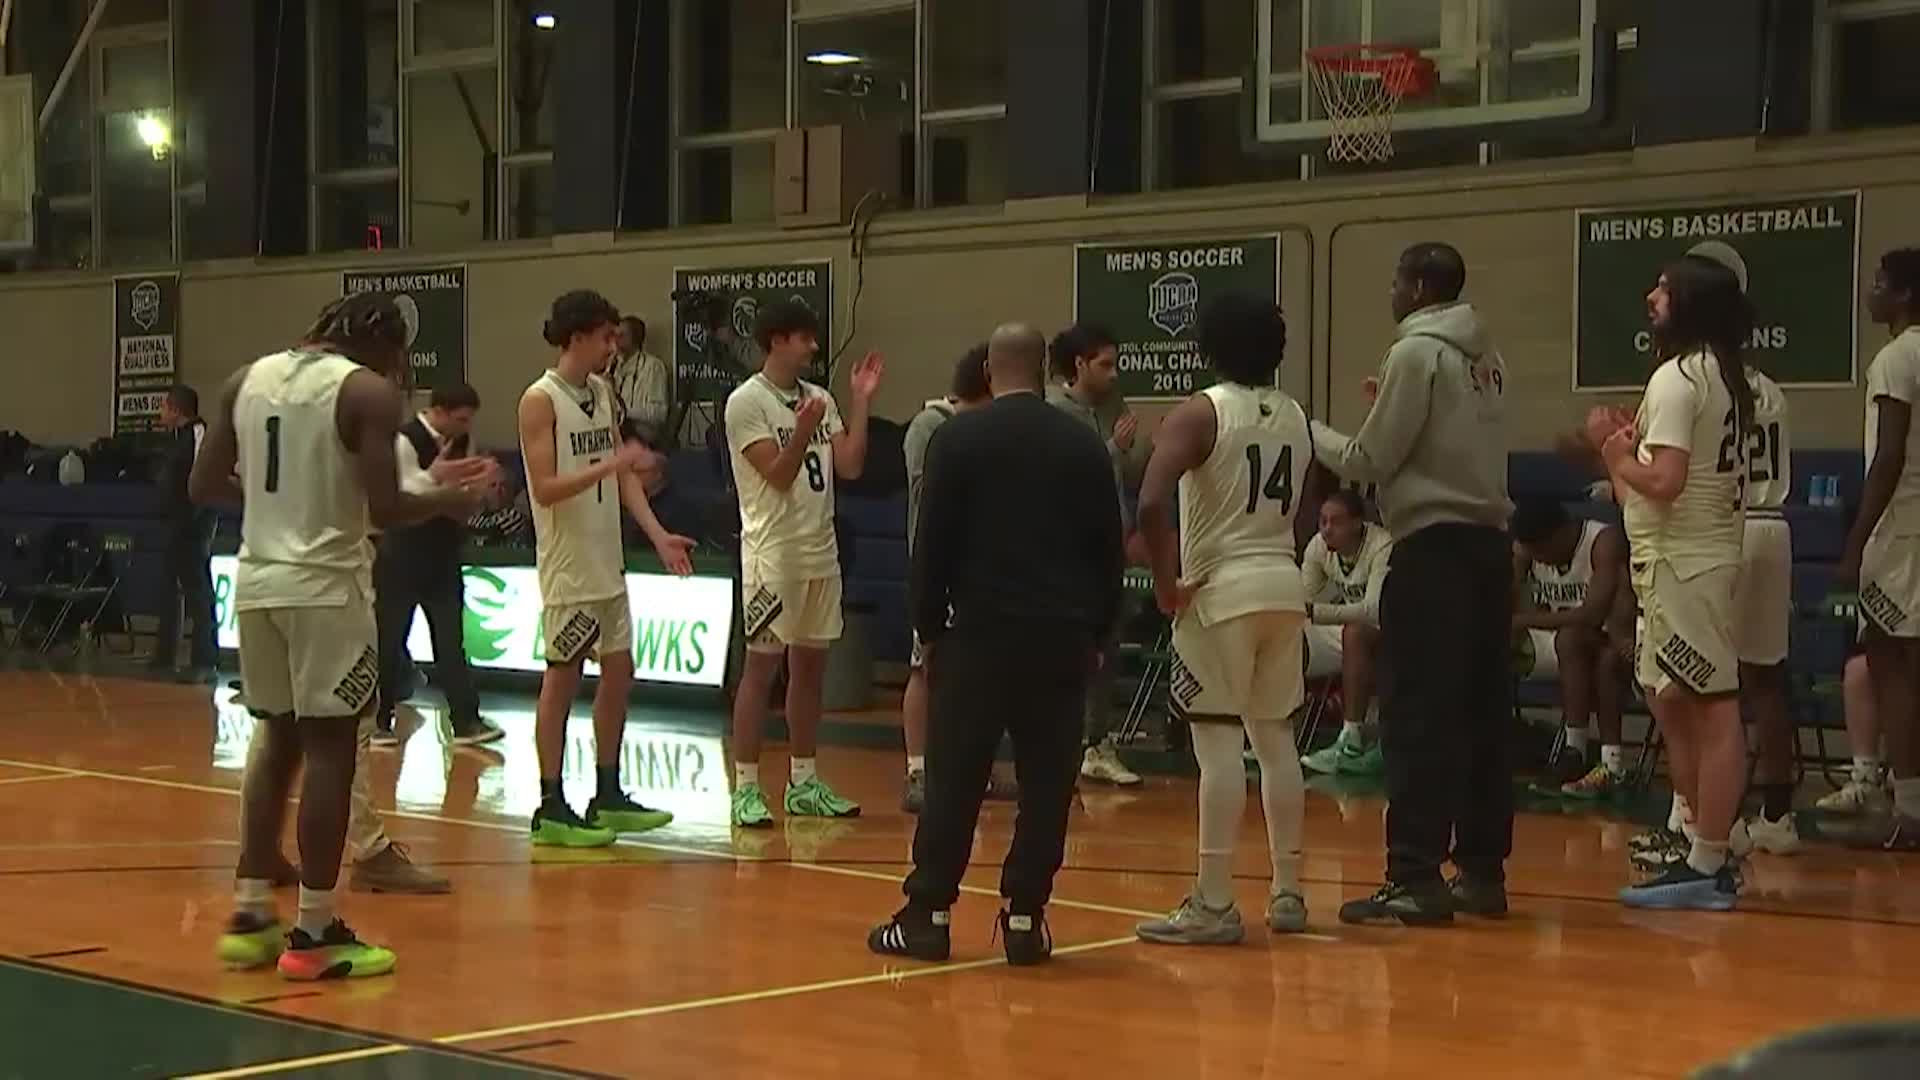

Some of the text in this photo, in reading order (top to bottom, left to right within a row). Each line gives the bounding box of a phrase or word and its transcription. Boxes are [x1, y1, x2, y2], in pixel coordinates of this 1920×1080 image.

[1590, 206, 1843, 241] MEN'S BASKETBALL
[688, 269, 816, 291] WOMEN'S SOCCER
[1106, 247, 1243, 272] MEN'S SOCCER
[348, 272, 460, 293] MEN'S BASKETBALL
[1118, 354, 1163, 371] ONAL
[1153, 373, 1193, 392] 2016
[266, 416, 280, 492] 1
[805, 451, 825, 492] 8
[1749, 422, 1779, 482] 21
[1246, 444, 1293, 516] 14
[1862, 581, 1907, 632] BRISTOL
[552, 610, 598, 659] BRISTOL
[1662, 633, 1717, 689] BRISTOL
